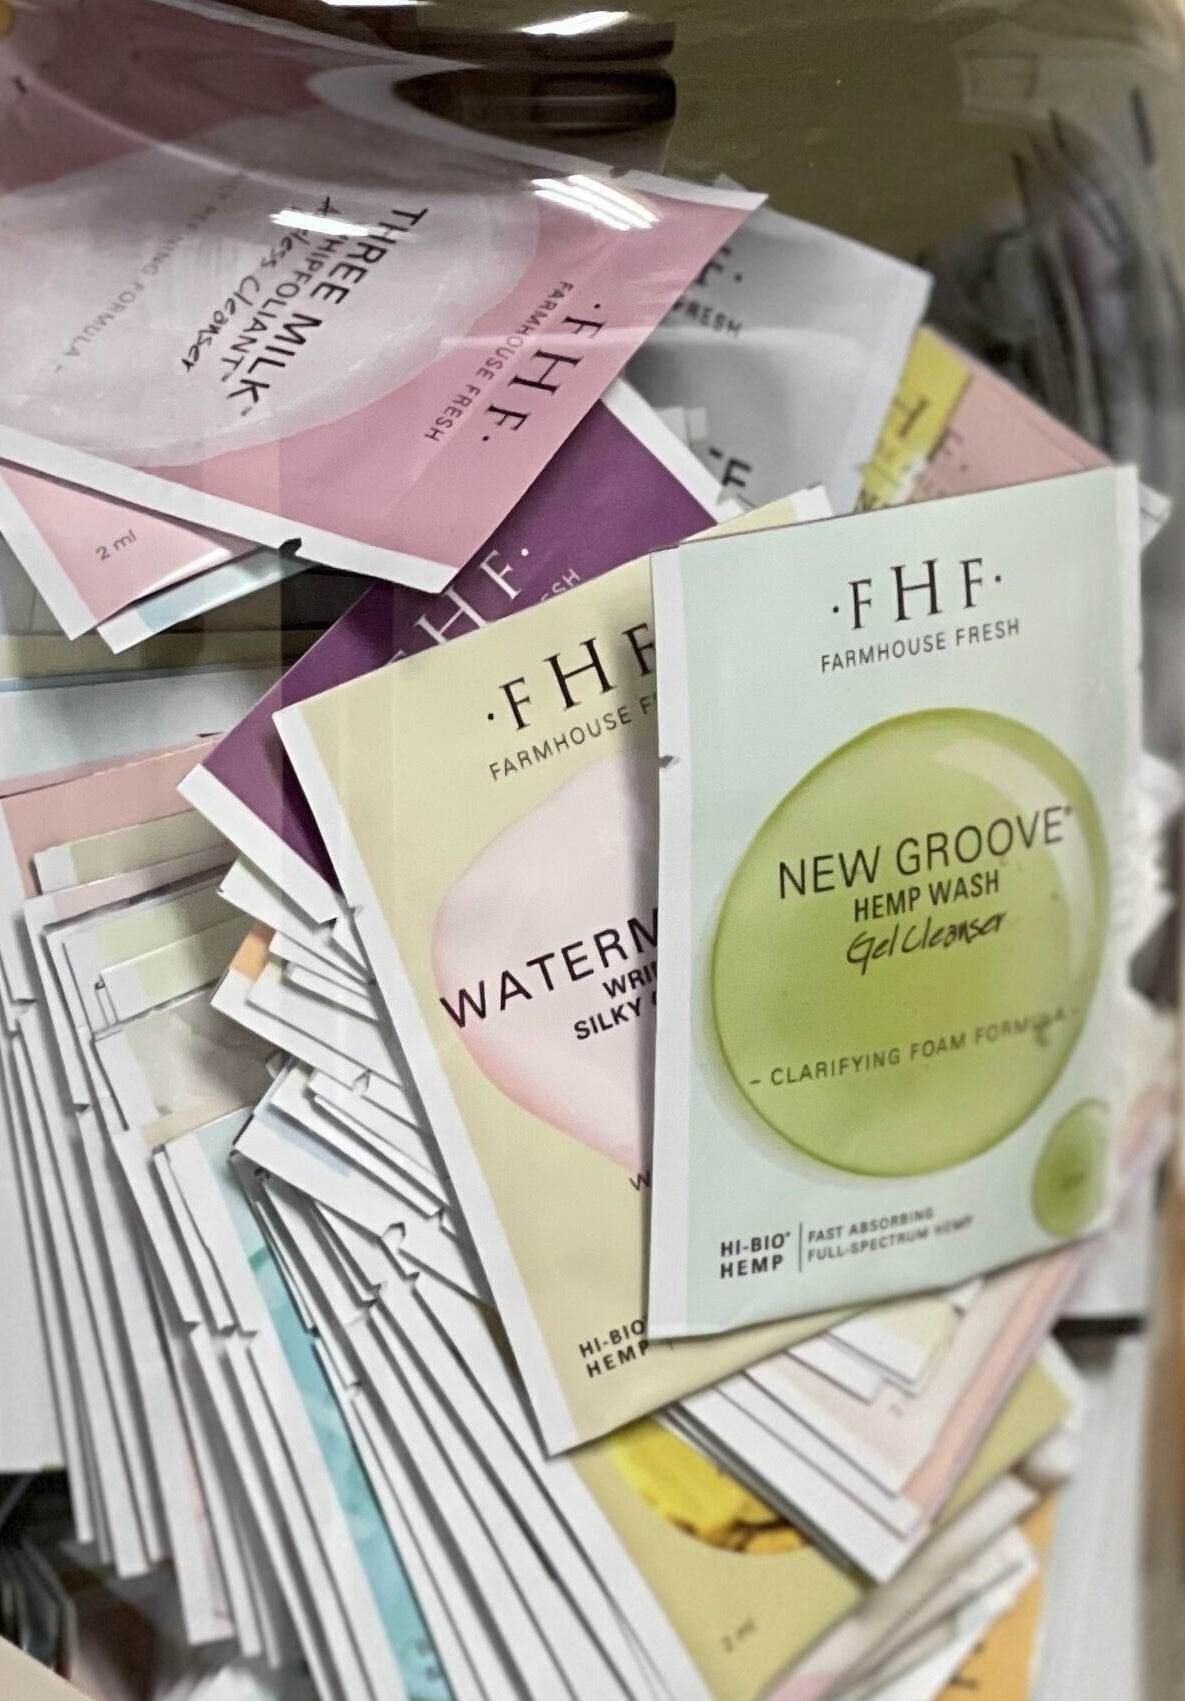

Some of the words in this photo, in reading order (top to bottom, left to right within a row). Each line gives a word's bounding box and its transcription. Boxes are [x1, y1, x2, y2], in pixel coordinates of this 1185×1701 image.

[309, 207, 429, 305] THREE
[63, 280, 146, 358] FORMULA
[181, 274, 260, 373] Cleanser
[476, 280, 574, 381] FARMHOUSE
[423, 384, 481, 443] FRESH
[96, 545, 111, 561] 2
[113, 528, 137, 551] ml
[820, 631, 947, 674] FARMHOUSE
[955, 617, 1020, 647] FRESH
[489, 706, 633, 782] FARMHOUSE
[777, 845, 882, 901] NEW
[853, 886, 922, 923] HEMP
[928, 868, 1000, 907] WASH
[845, 923, 900, 977] Gel
[900, 911, 1008, 954] Cleanser
[573, 996, 642, 1041] SILKY
[770, 1047, 901, 1087] CLARIFYING
[909, 1031, 967, 1061] FOAM
[807, 1224, 844, 1244] FAST
[848, 1206, 935, 1237] ABSORBING
[807, 1228, 929, 1263] FULL-SPECTRUM
[719, 1253, 785, 1280] HEMP
[586, 1338, 651, 1379] HEMP
